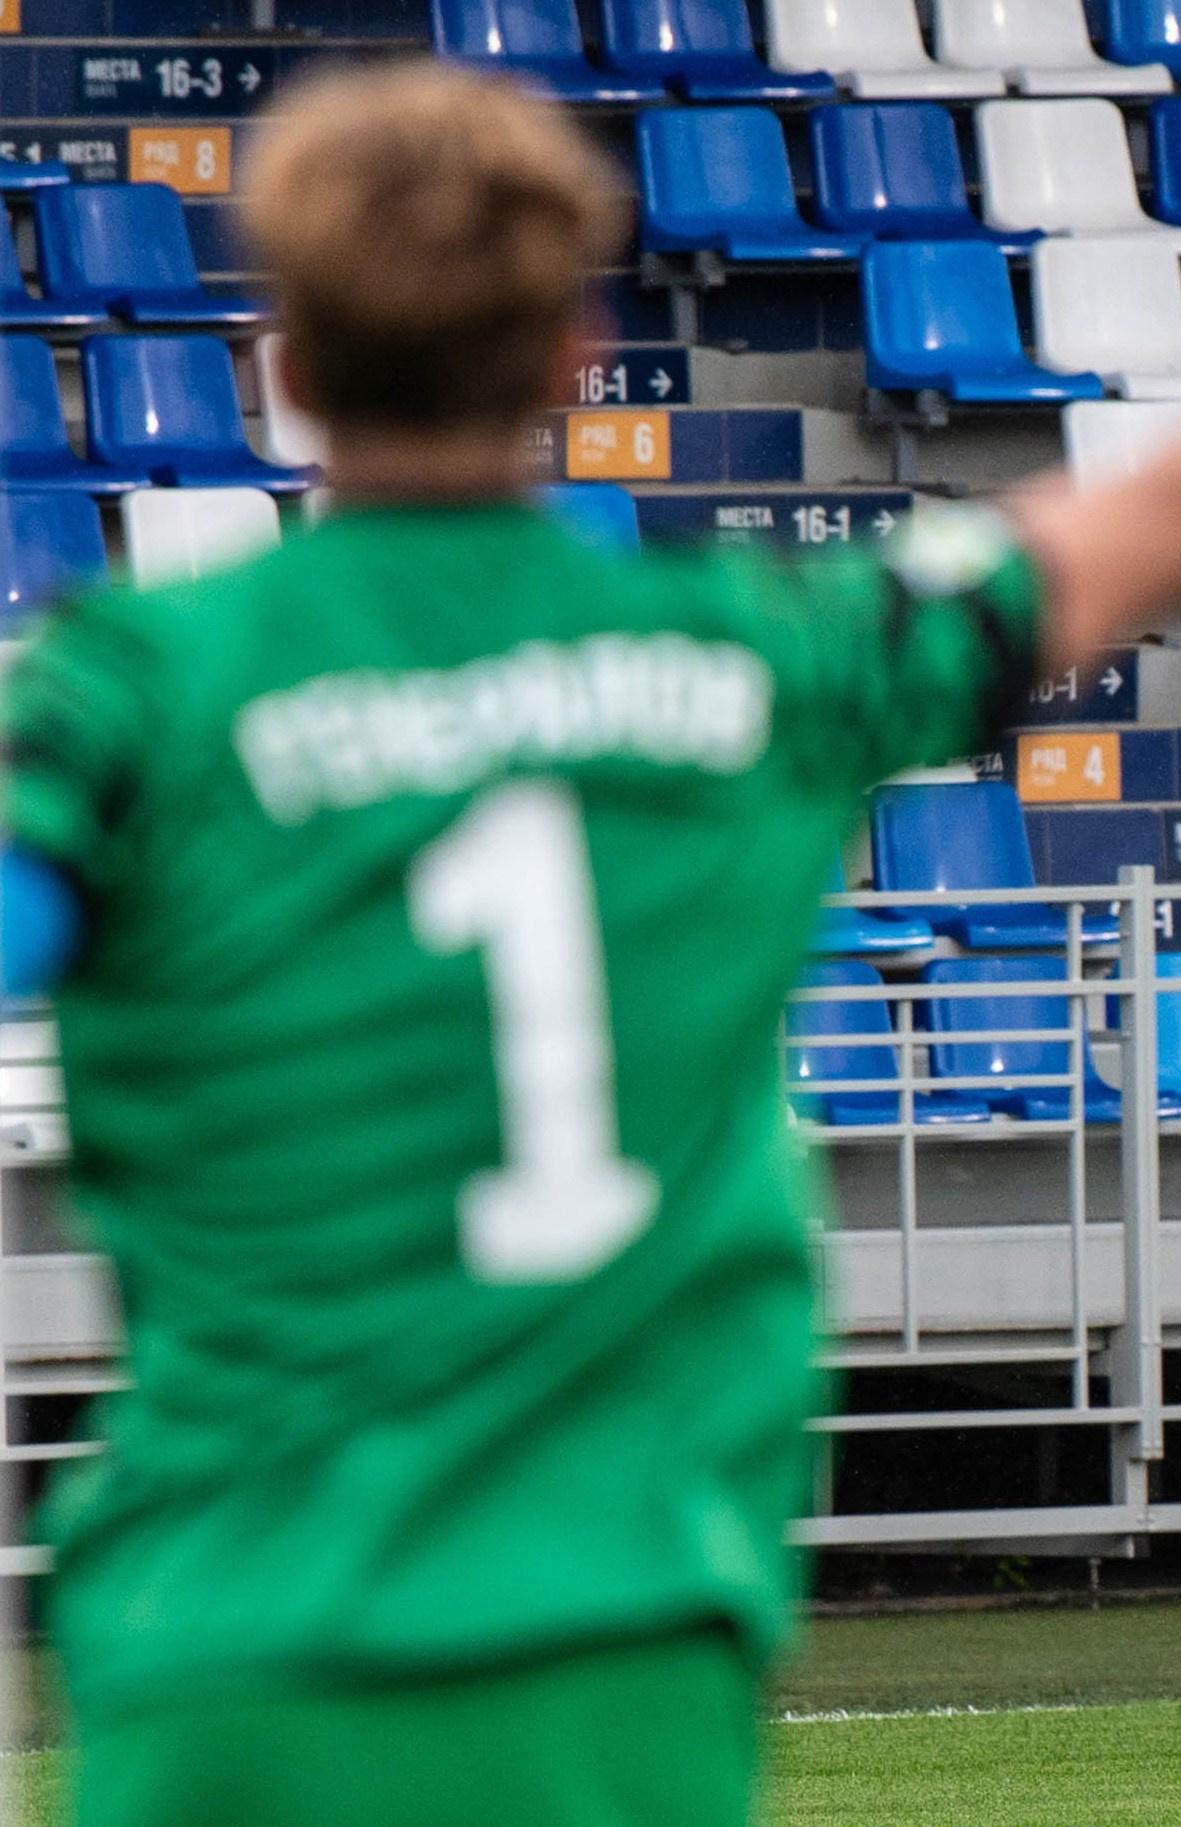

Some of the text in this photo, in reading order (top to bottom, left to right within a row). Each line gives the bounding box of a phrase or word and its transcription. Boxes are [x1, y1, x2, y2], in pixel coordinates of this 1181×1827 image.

[156, 58, 222, 98] 16-3
[196, 139, 214, 180] 8
[575, 364, 627, 402] 16-1
[633, 422, 654, 464] 6
[717, 505, 849, 543] МЕСТА 16-1
[1030, 665, 1077, 703] 6-1
[1084, 745, 1105, 786] 4
[410, 778, 662, 1286] 1
